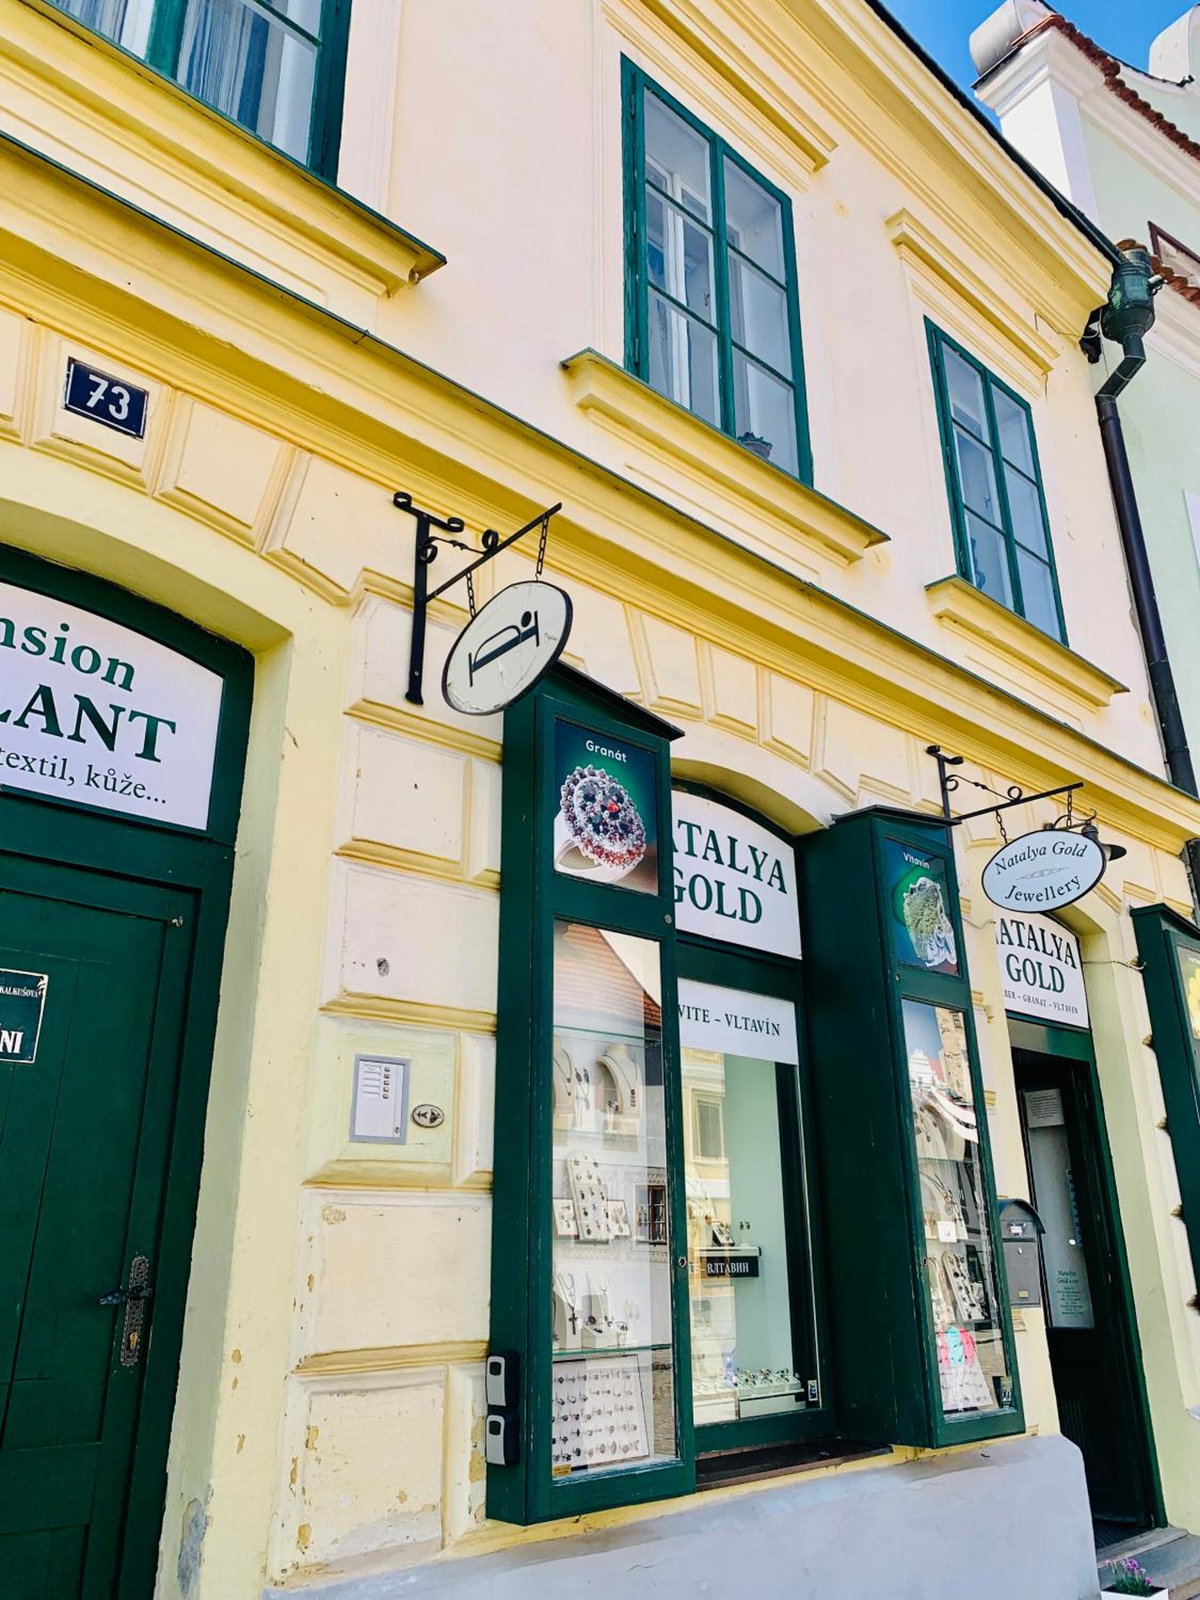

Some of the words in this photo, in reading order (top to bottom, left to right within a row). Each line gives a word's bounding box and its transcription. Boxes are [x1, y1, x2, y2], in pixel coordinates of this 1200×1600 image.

[86, 373, 131, 420] 73
[585, 739, 628, 763] Granát
[0, 746, 76, 787] extil,
[84, 764, 167, 805] kůže...
[672, 819, 788, 895] TALYA
[994, 845, 1048, 876] Natalya
[1052, 840, 1089, 859] Gold
[1004, 874, 1082, 903] Jewellery
[996, 917, 1078, 970] ATALYA
[1005, 953, 1065, 994] GOLD
[724, 1012, 781, 1037] VLTAVÍN
